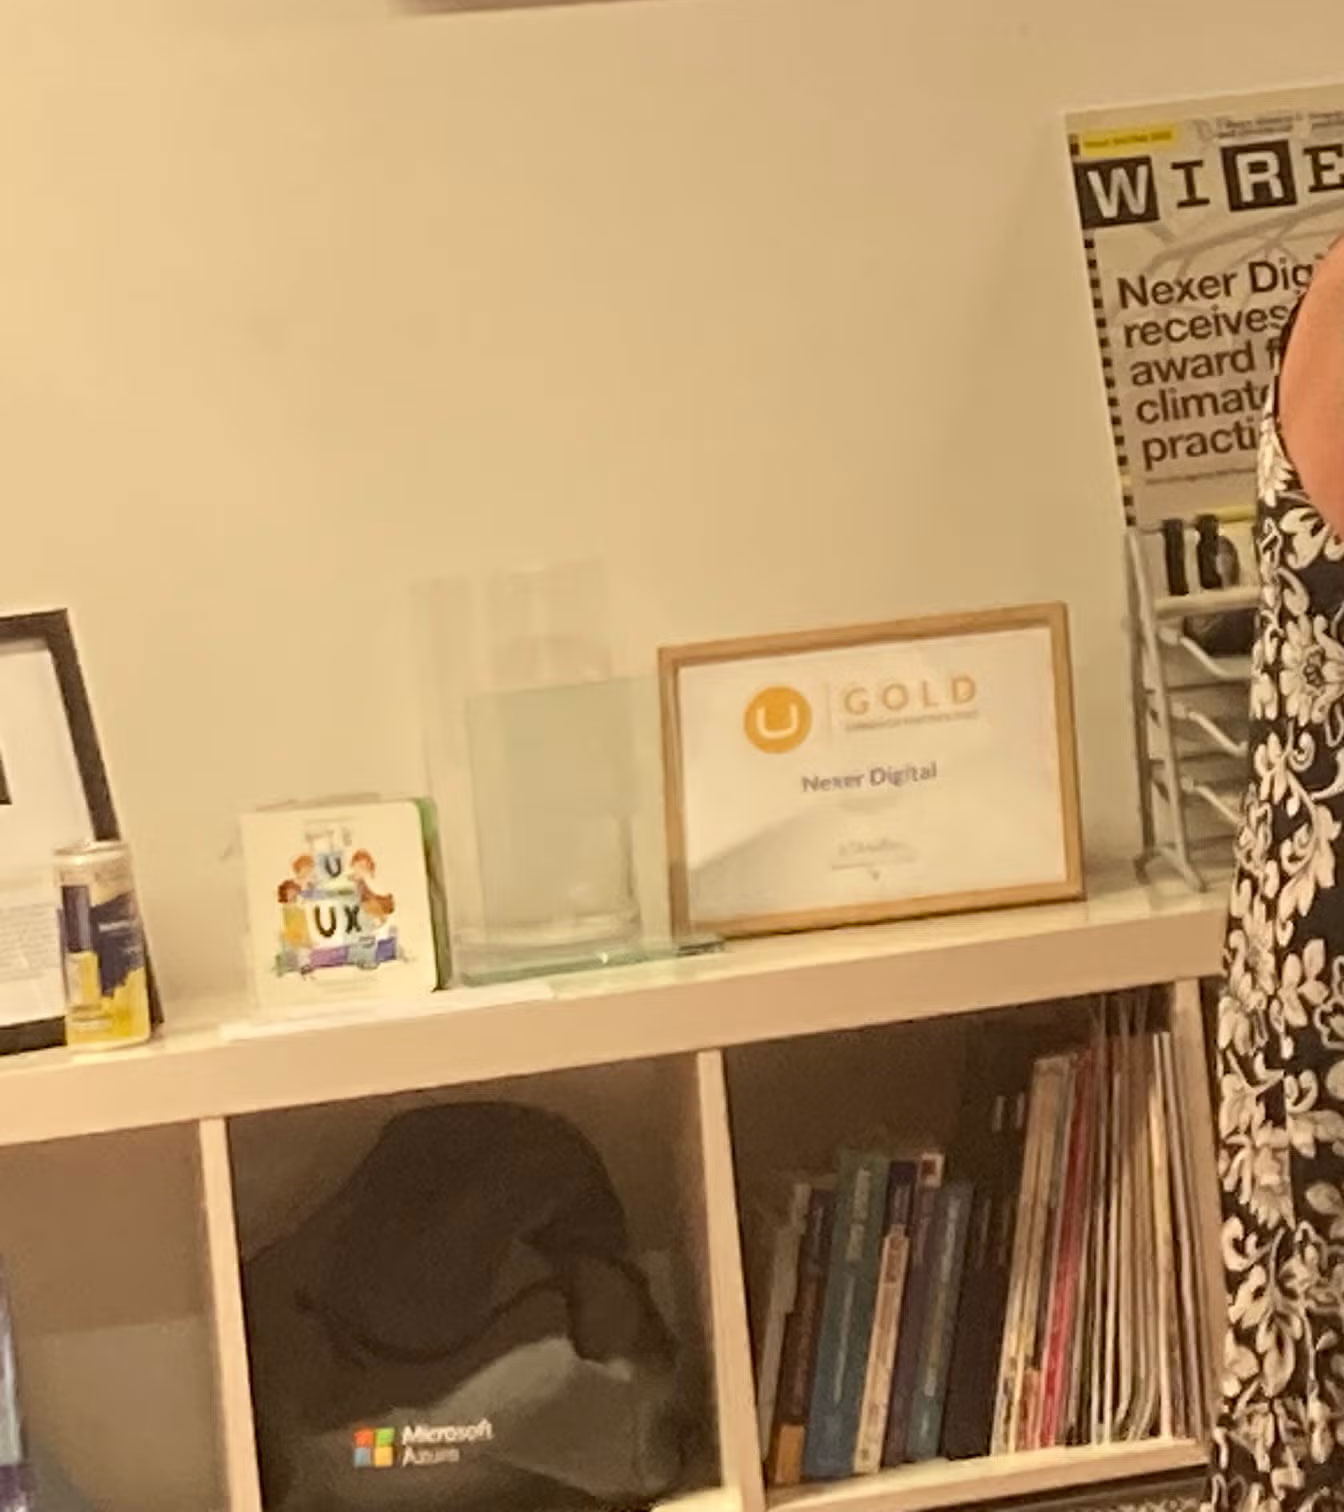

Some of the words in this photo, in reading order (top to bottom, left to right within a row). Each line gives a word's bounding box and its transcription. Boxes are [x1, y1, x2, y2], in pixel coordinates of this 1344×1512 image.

[1117, 270, 1238, 310] Nexer
[1247, 253, 1325, 294] Dig
[1123, 304, 1289, 348] receives
[1130, 339, 1255, 386] award
[1141, 416, 1258, 471] practi
[843, 674, 976, 716] GOLD
[869, 760, 937, 787] Digital
[402, 1417, 494, 1446] Microsoft
